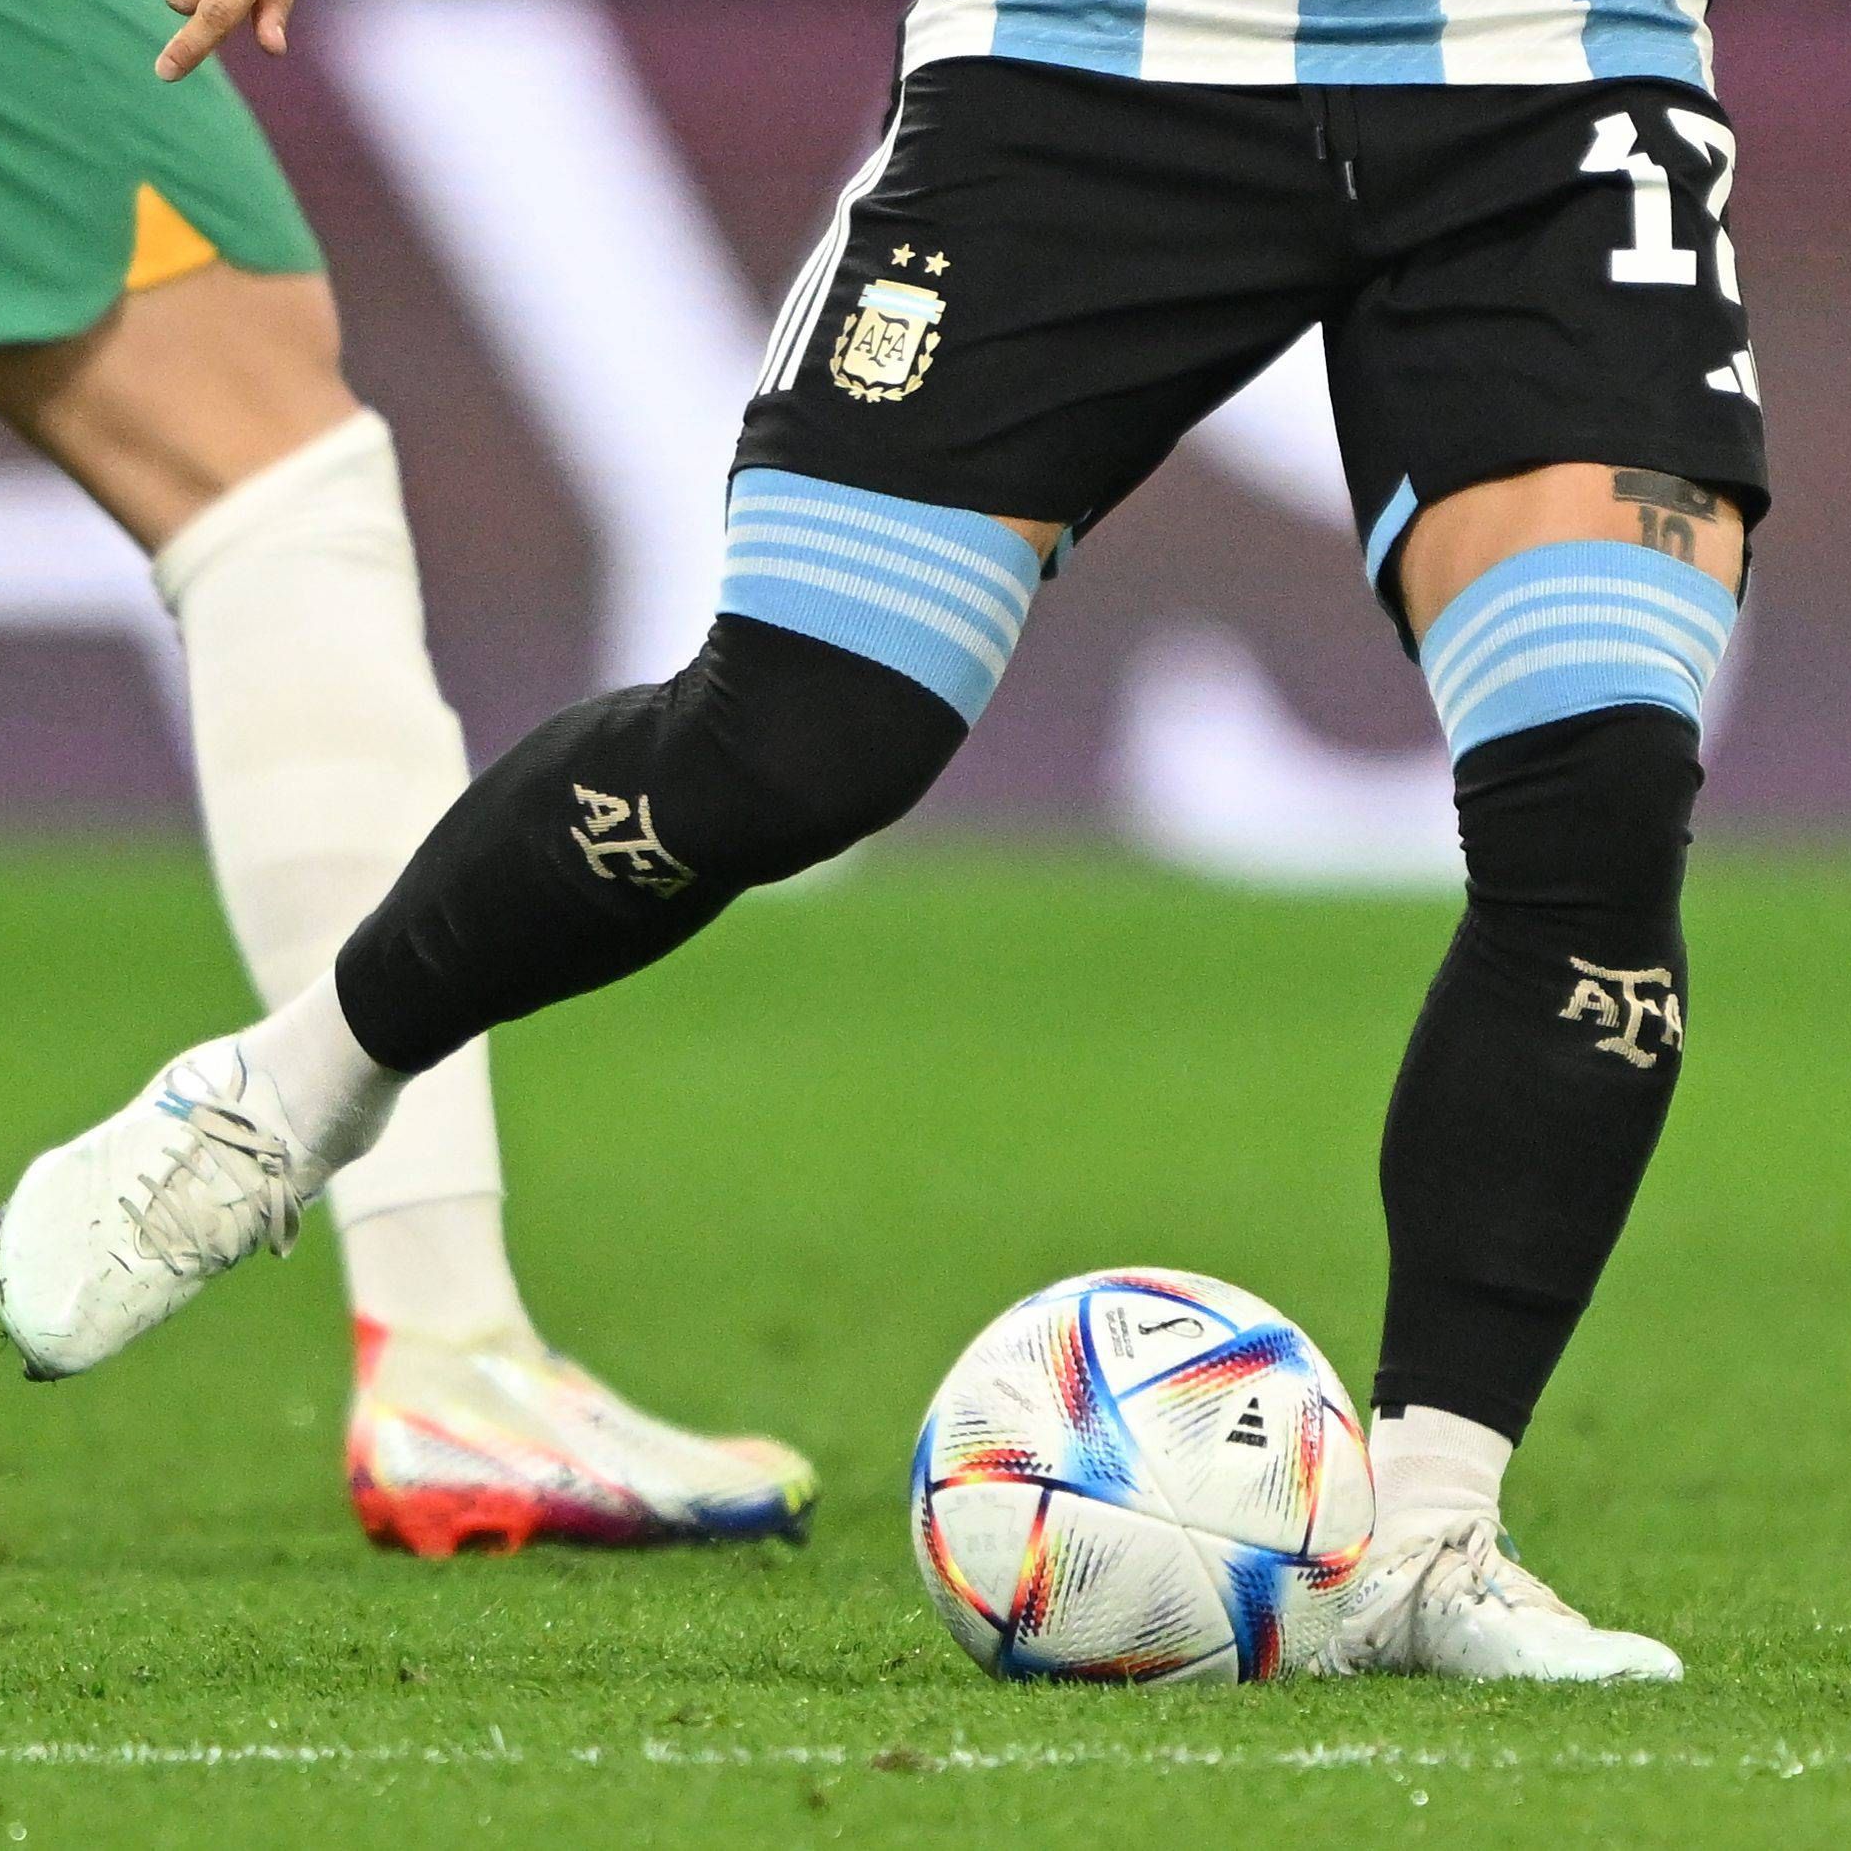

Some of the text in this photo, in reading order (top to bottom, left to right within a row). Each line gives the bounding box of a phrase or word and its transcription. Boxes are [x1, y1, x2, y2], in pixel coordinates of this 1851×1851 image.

[854, 311, 911, 368] AFA
[570, 782, 699, 901] AFA
[1558, 955, 1684, 1069] AFA
[1349, 1579, 1381, 1613] OPA
